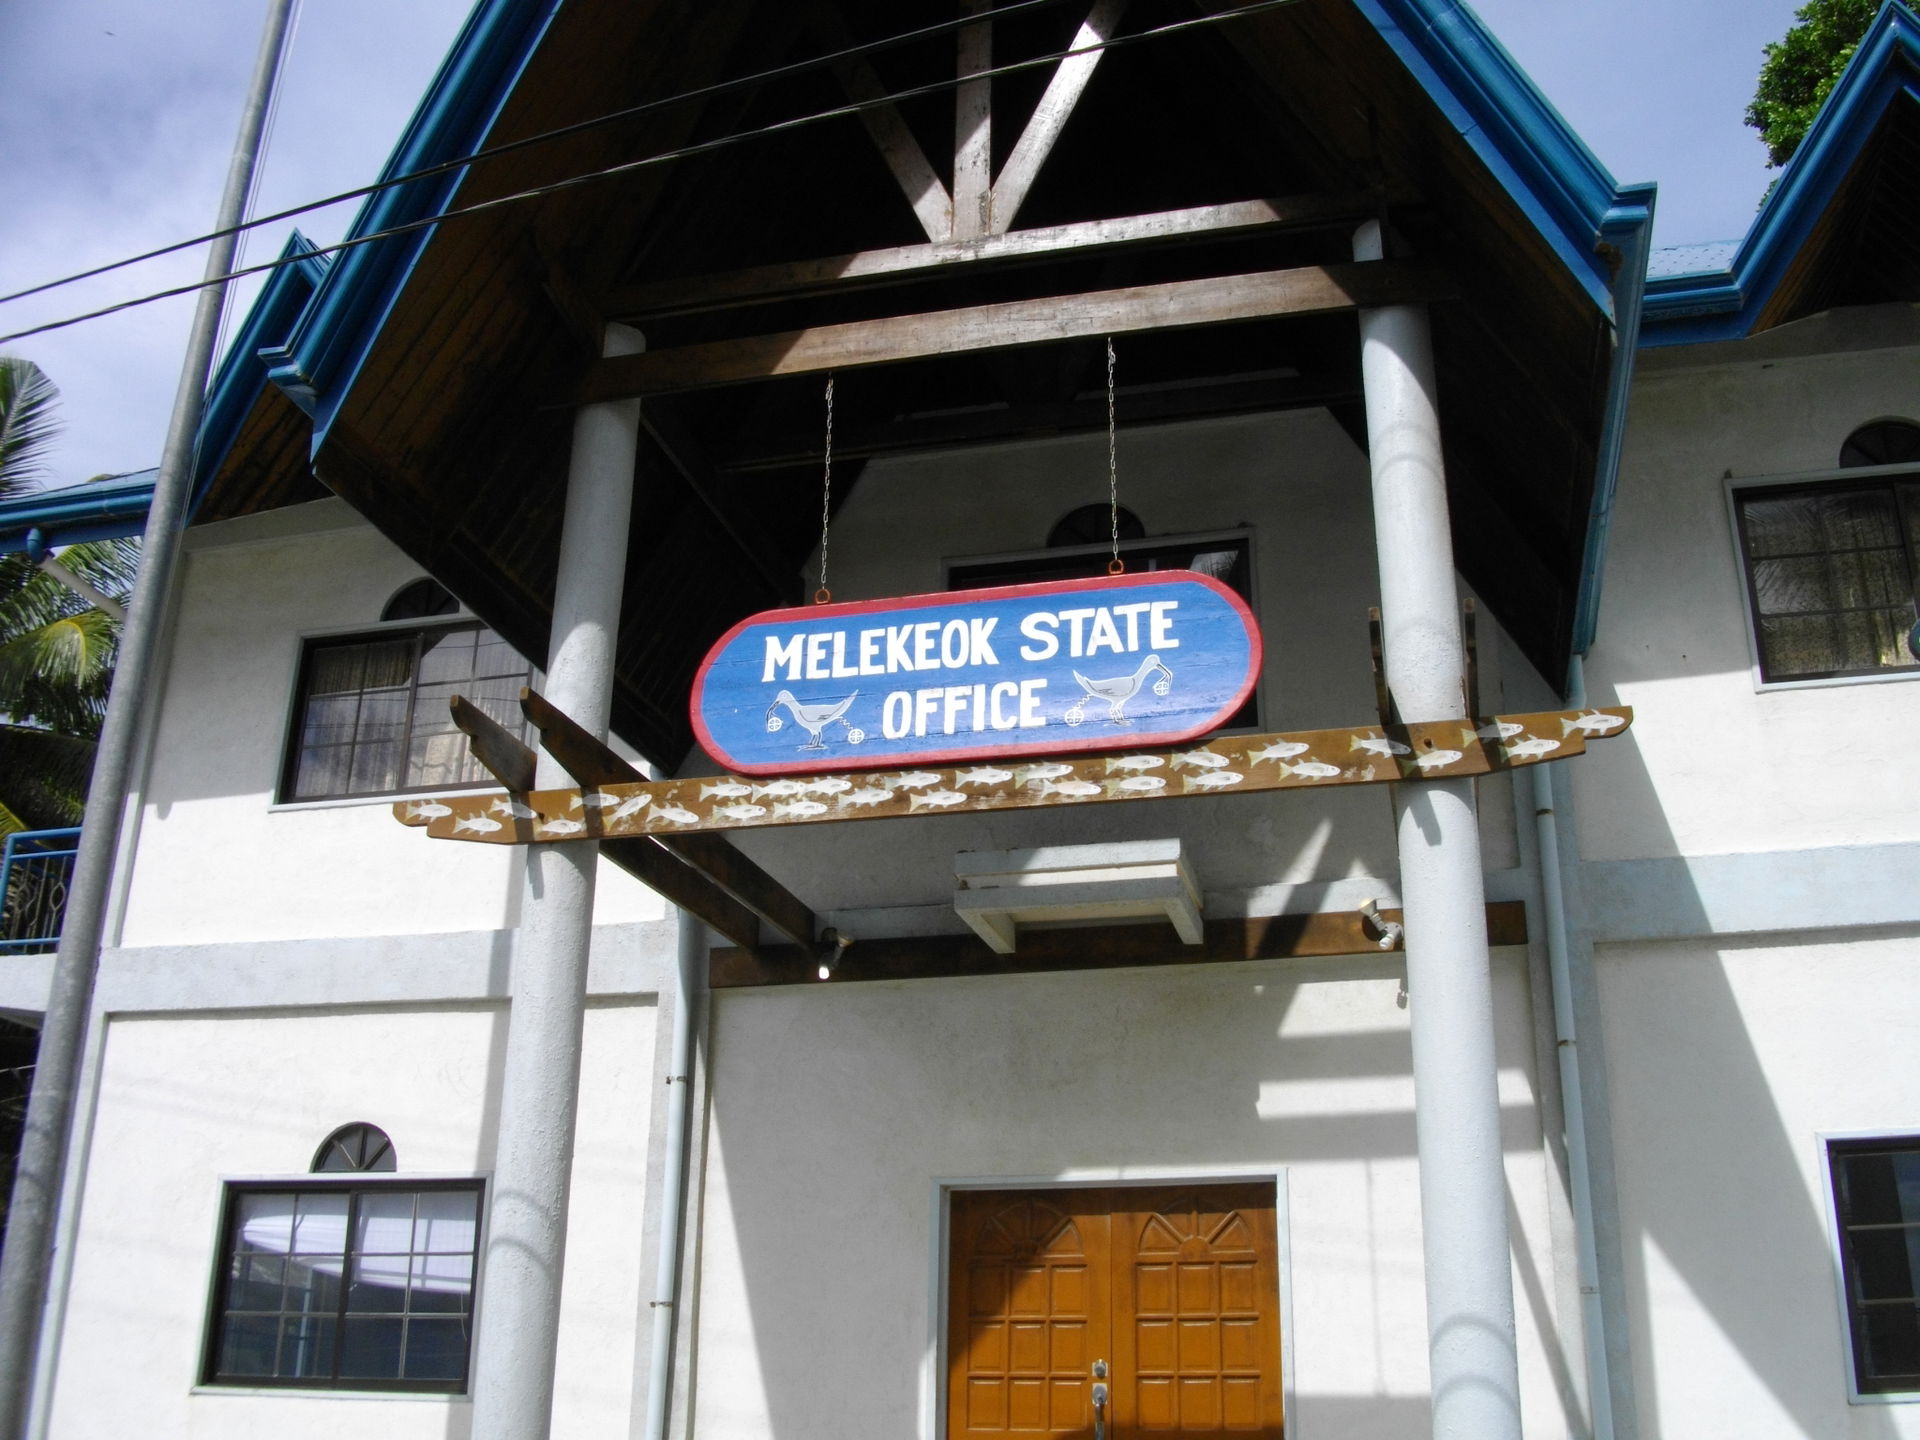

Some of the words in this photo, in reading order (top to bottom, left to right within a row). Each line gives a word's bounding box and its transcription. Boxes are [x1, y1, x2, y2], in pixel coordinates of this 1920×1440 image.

[762, 617, 999, 683] MELEKEOK
[1020, 601, 1180, 661] STATE
[882, 678, 1048, 740] OFFICE
